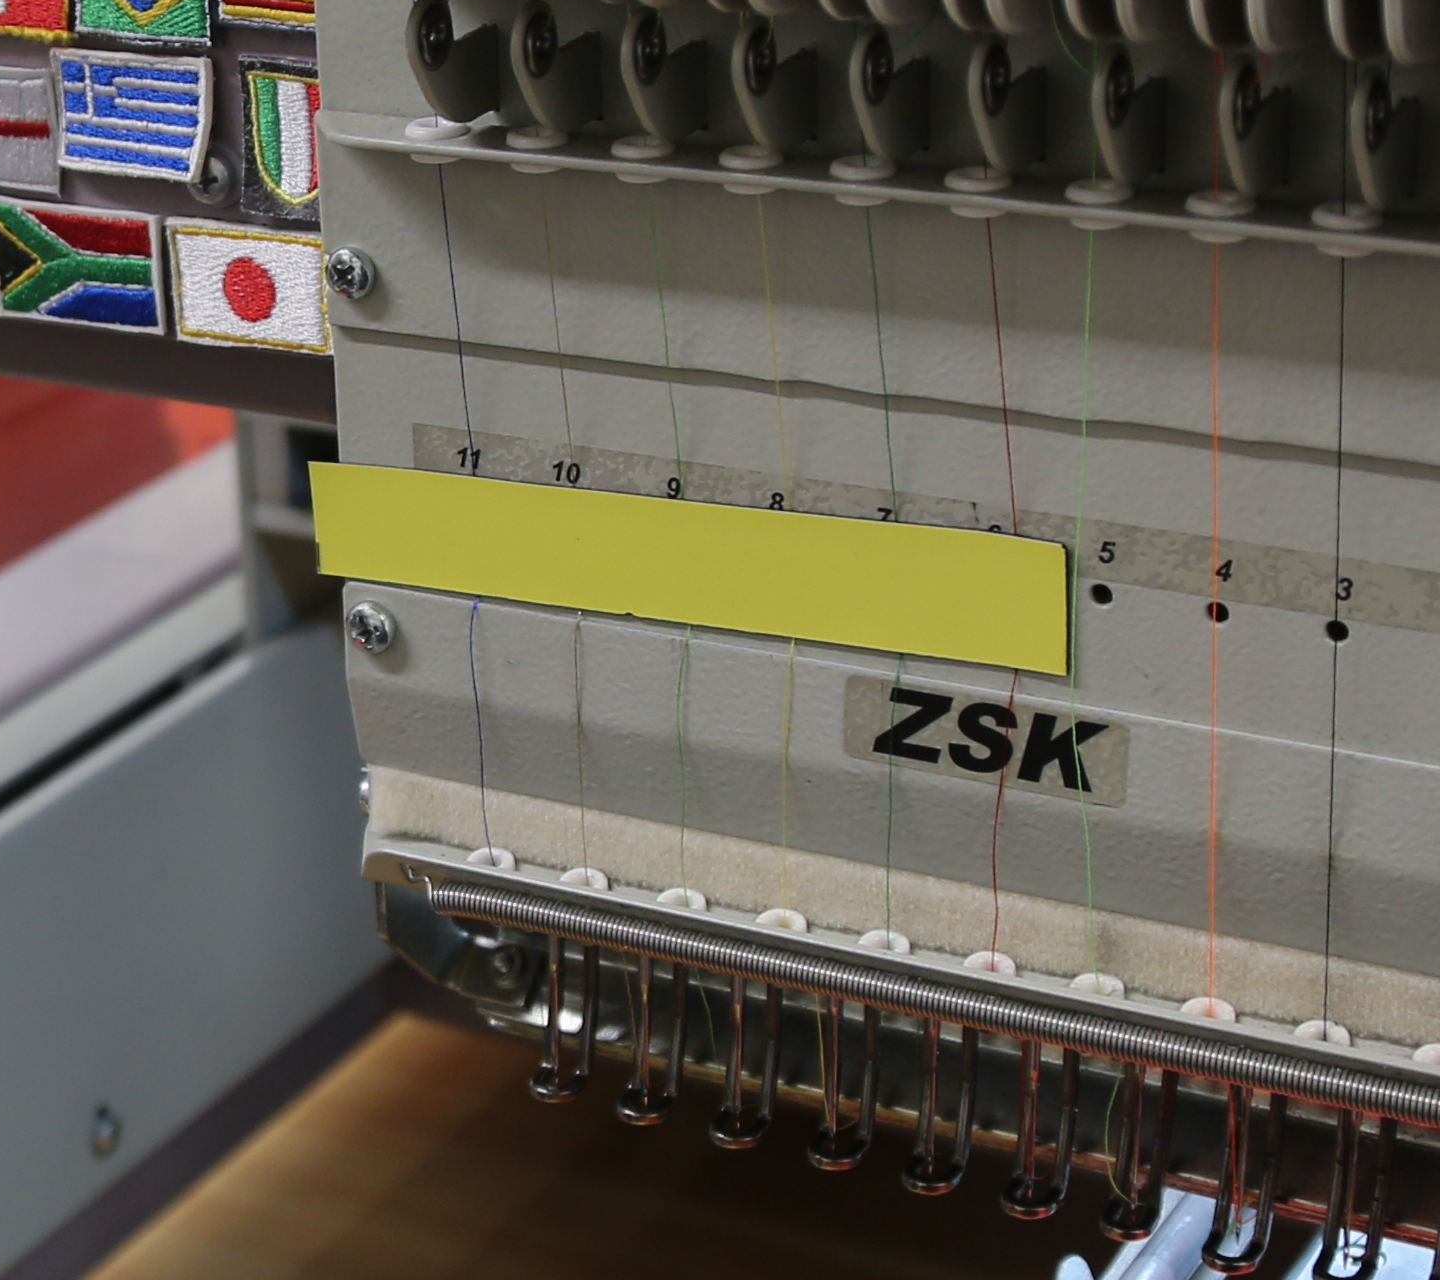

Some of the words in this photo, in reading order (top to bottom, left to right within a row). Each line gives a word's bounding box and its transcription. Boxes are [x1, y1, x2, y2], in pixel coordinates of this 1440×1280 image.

[456, 446, 482, 470] 11
[552, 461, 581, 485] 10
[666, 477, 682, 499] 9
[1098, 541, 1117, 564] 5
[1215, 558, 1233, 583] 4
[1336, 577, 1353, 601] 3
[872, 687, 1110, 793] ZSK
